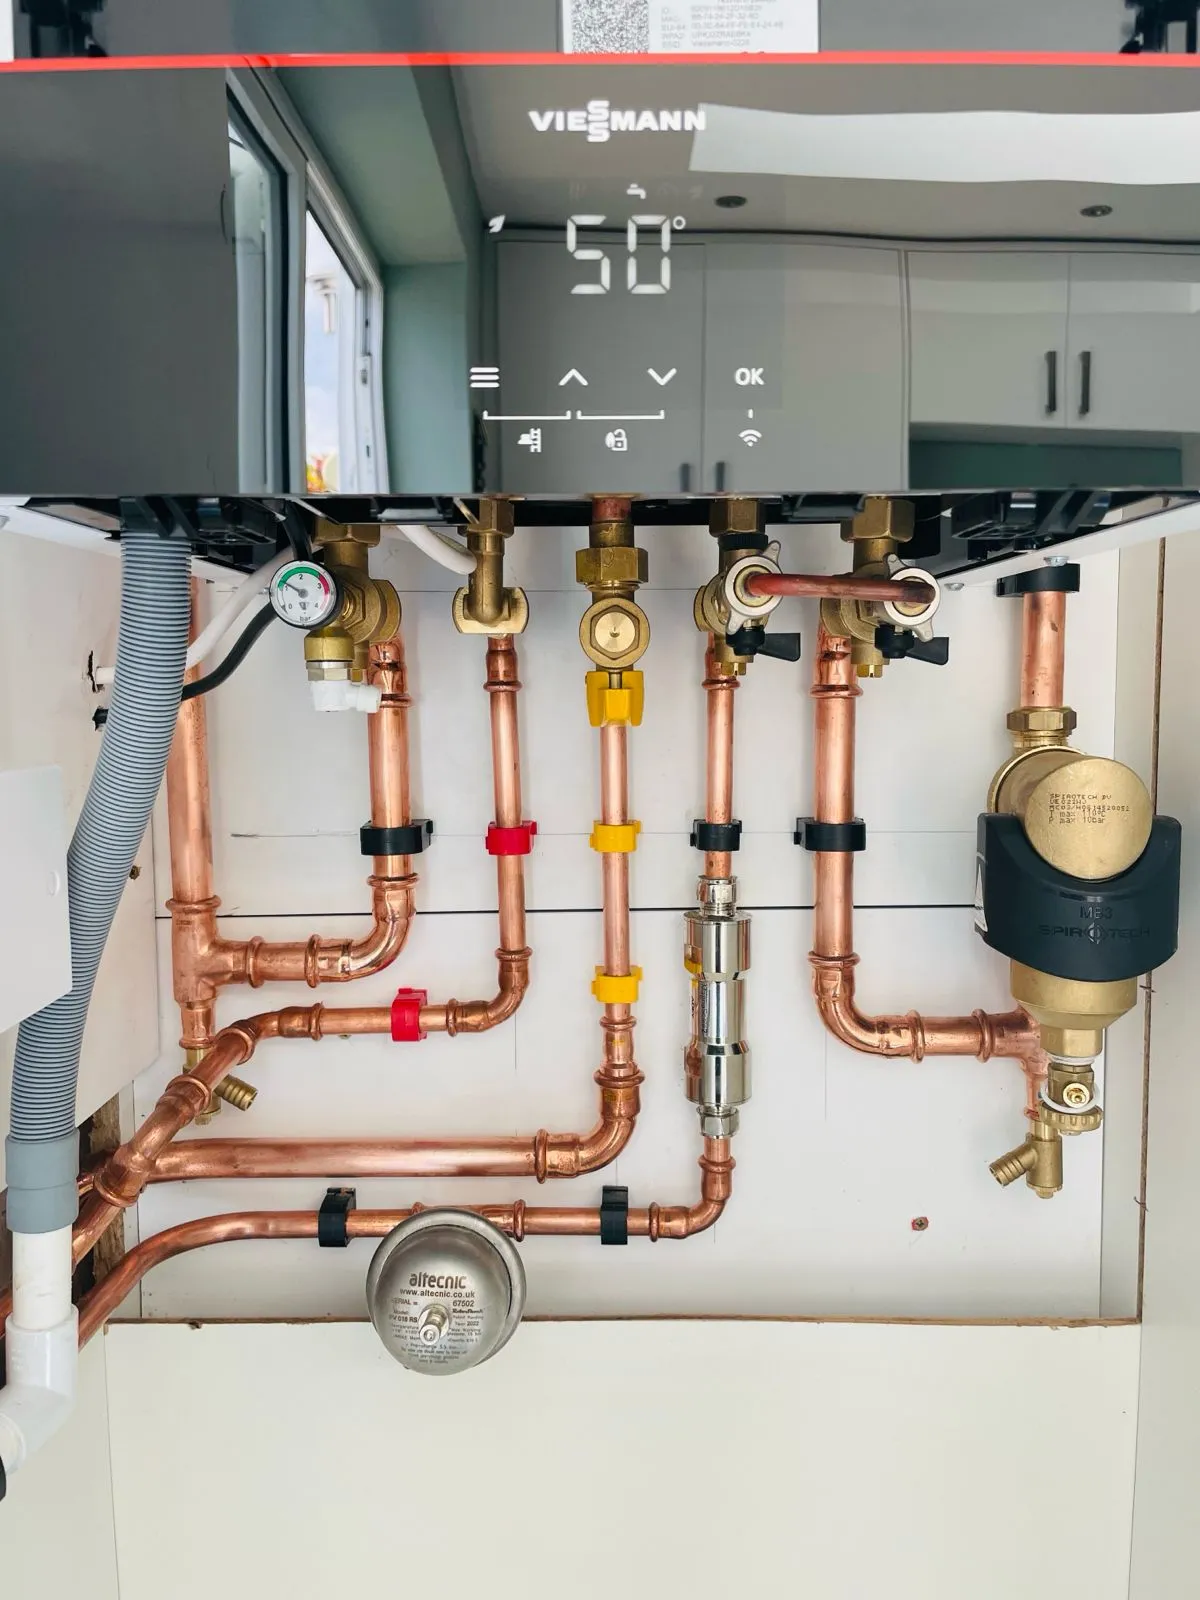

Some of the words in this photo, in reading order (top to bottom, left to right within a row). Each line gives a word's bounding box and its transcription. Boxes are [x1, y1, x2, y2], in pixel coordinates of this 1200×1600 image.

[528, 100, 706, 142] VIESSMANN
[734, 367, 765, 386] OK
[1079, 905, 1113, 920] MB3
[409, 1272, 467, 1289] altecnic
[400, 1288, 475, 1298] www.altecnic.co.uk
